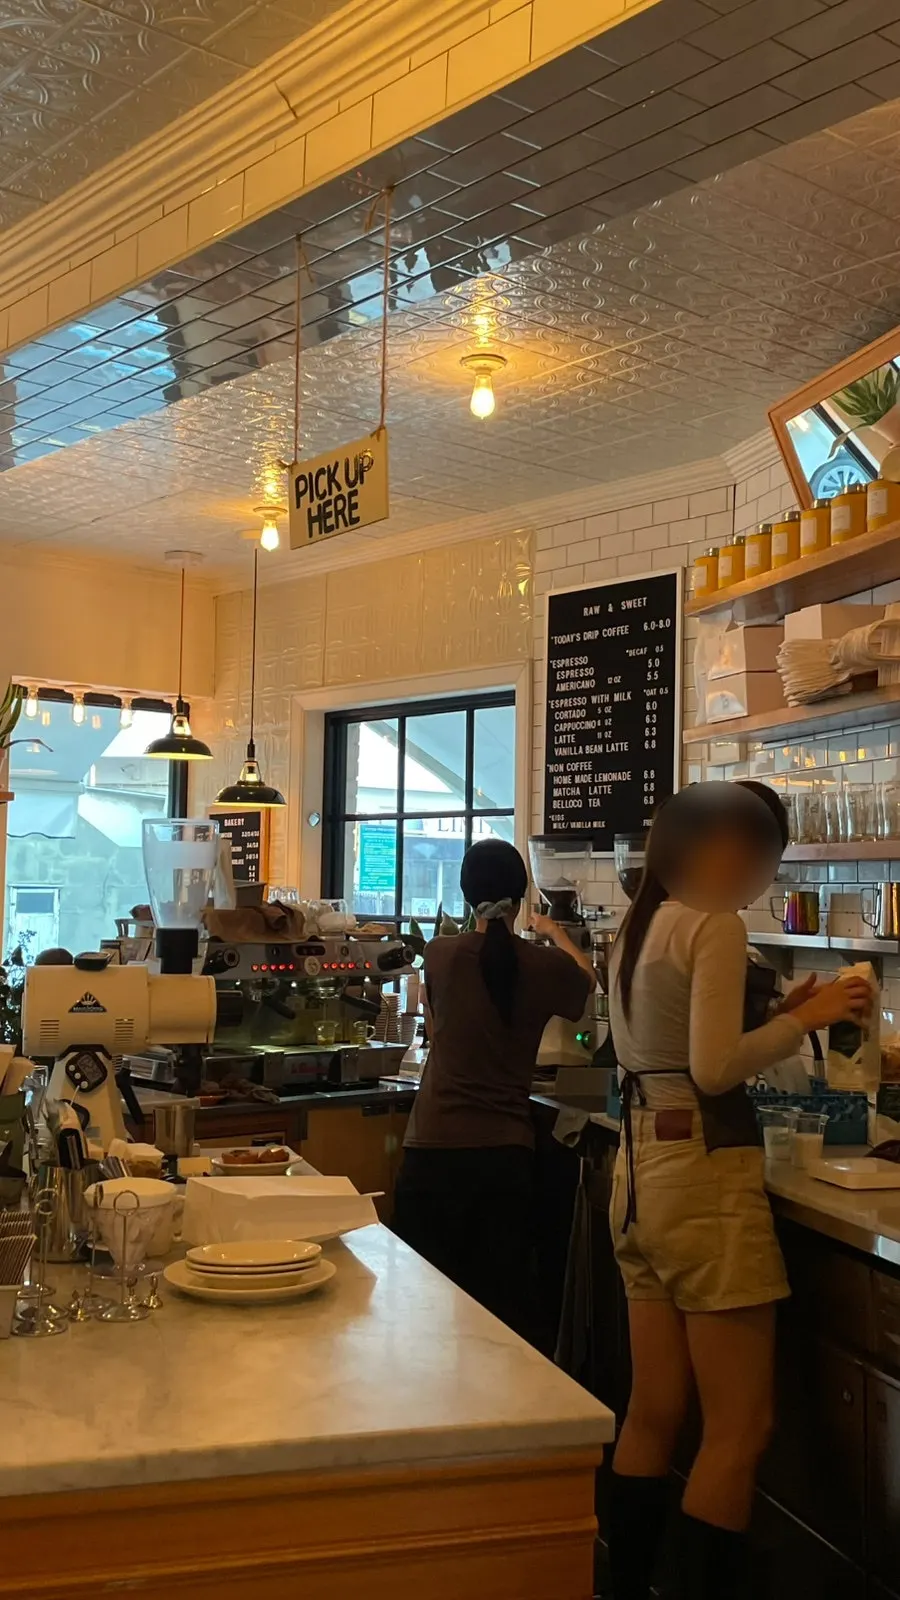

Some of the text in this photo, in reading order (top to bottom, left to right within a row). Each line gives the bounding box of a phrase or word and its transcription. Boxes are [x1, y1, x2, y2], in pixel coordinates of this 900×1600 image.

[295, 452, 374, 509] PICK UP
[307, 488, 360, 538] HERE
[583, 597, 647, 616] RAW & SWEET
[583, 630, 599, 641] DRIP
[602, 625, 629, 637] COFFEE
[647, 658, 660, 668] 5.0
[556, 667, 659, 681] ESPRESSO 5.5
[556, 679, 596, 692] AMERICANO
[591, 694, 610, 704] WITH
[613, 691, 632, 702] MILK
[554, 709, 586, 720] CORTADO
[645, 701, 657, 711] 6.0
[554, 720, 597, 732] CAPPUCCINO
[645, 714, 657, 724] 6.3
[554, 734, 576, 745] LATTE
[644, 727, 657, 737] 6.3
[554, 740, 656, 757] VANILLA BEAN LATTE 6.8
[566, 761, 592, 771] COFFEE
[553, 770, 655, 785] HOME MADE LEMONADE 6.8
[553, 783, 655, 797] MATCHA LATTE 6.8
[588, 798, 601, 807] TEA
[643, 796, 655, 805] 6.8
[224, 818, 245, 827] BAKERY
[570, 821, 591, 829] VANILLA
